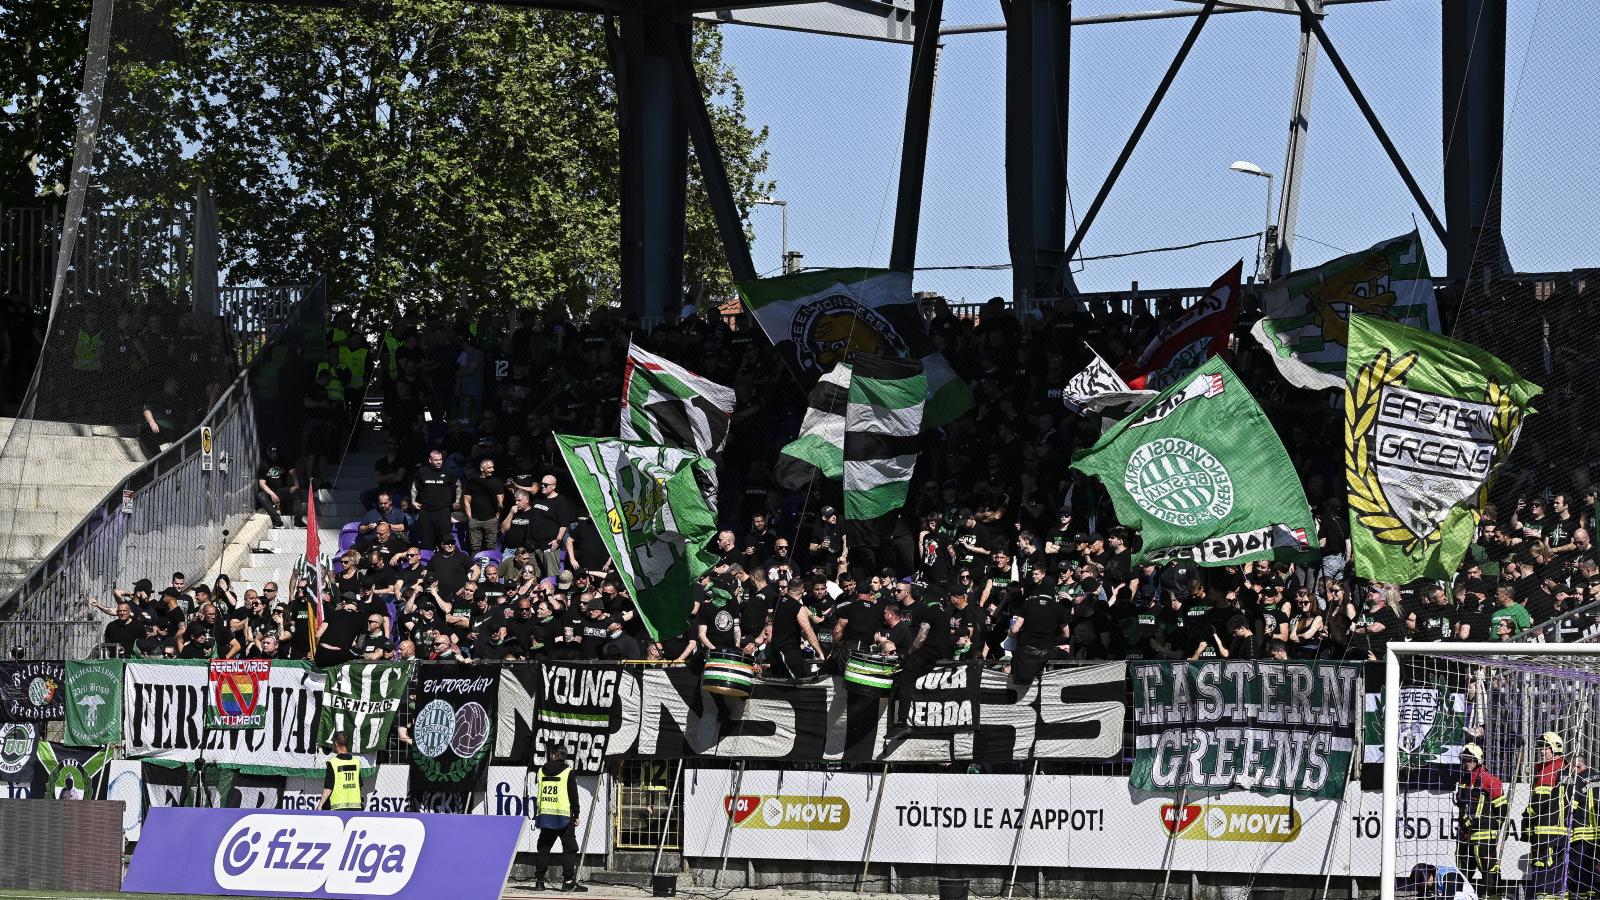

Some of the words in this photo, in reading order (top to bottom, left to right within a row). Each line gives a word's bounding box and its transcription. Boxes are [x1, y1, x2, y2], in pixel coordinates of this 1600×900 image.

[495, 360, 508, 377] 12
[1381, 392, 1492, 436] EASTERN
[1379, 434, 1490, 474] GREENS
[12, 661, 65, 689] Felvidé
[423, 674, 494, 695] BIATORBÁGY
[541, 663, 617, 707] YOUNG
[1135, 660, 1357, 727] EASTERN
[906, 699, 973, 727] ERDA
[1151, 727, 1332, 792] GREENS
[542, 785, 558, 796] 428
[784, 803, 843, 823] MOVE
[896, 800, 967, 829] TÖLTSD
[974, 806, 994, 829] LE
[1000, 807, 1026, 830] AZ
[1030, 808, 1104, 833] APPOT!
[1228, 813, 1292, 835] MOVE
[1352, 811, 1432, 840] TÖTSD
[263, 828, 332, 871] fizz
[338, 829, 406, 884] liga
